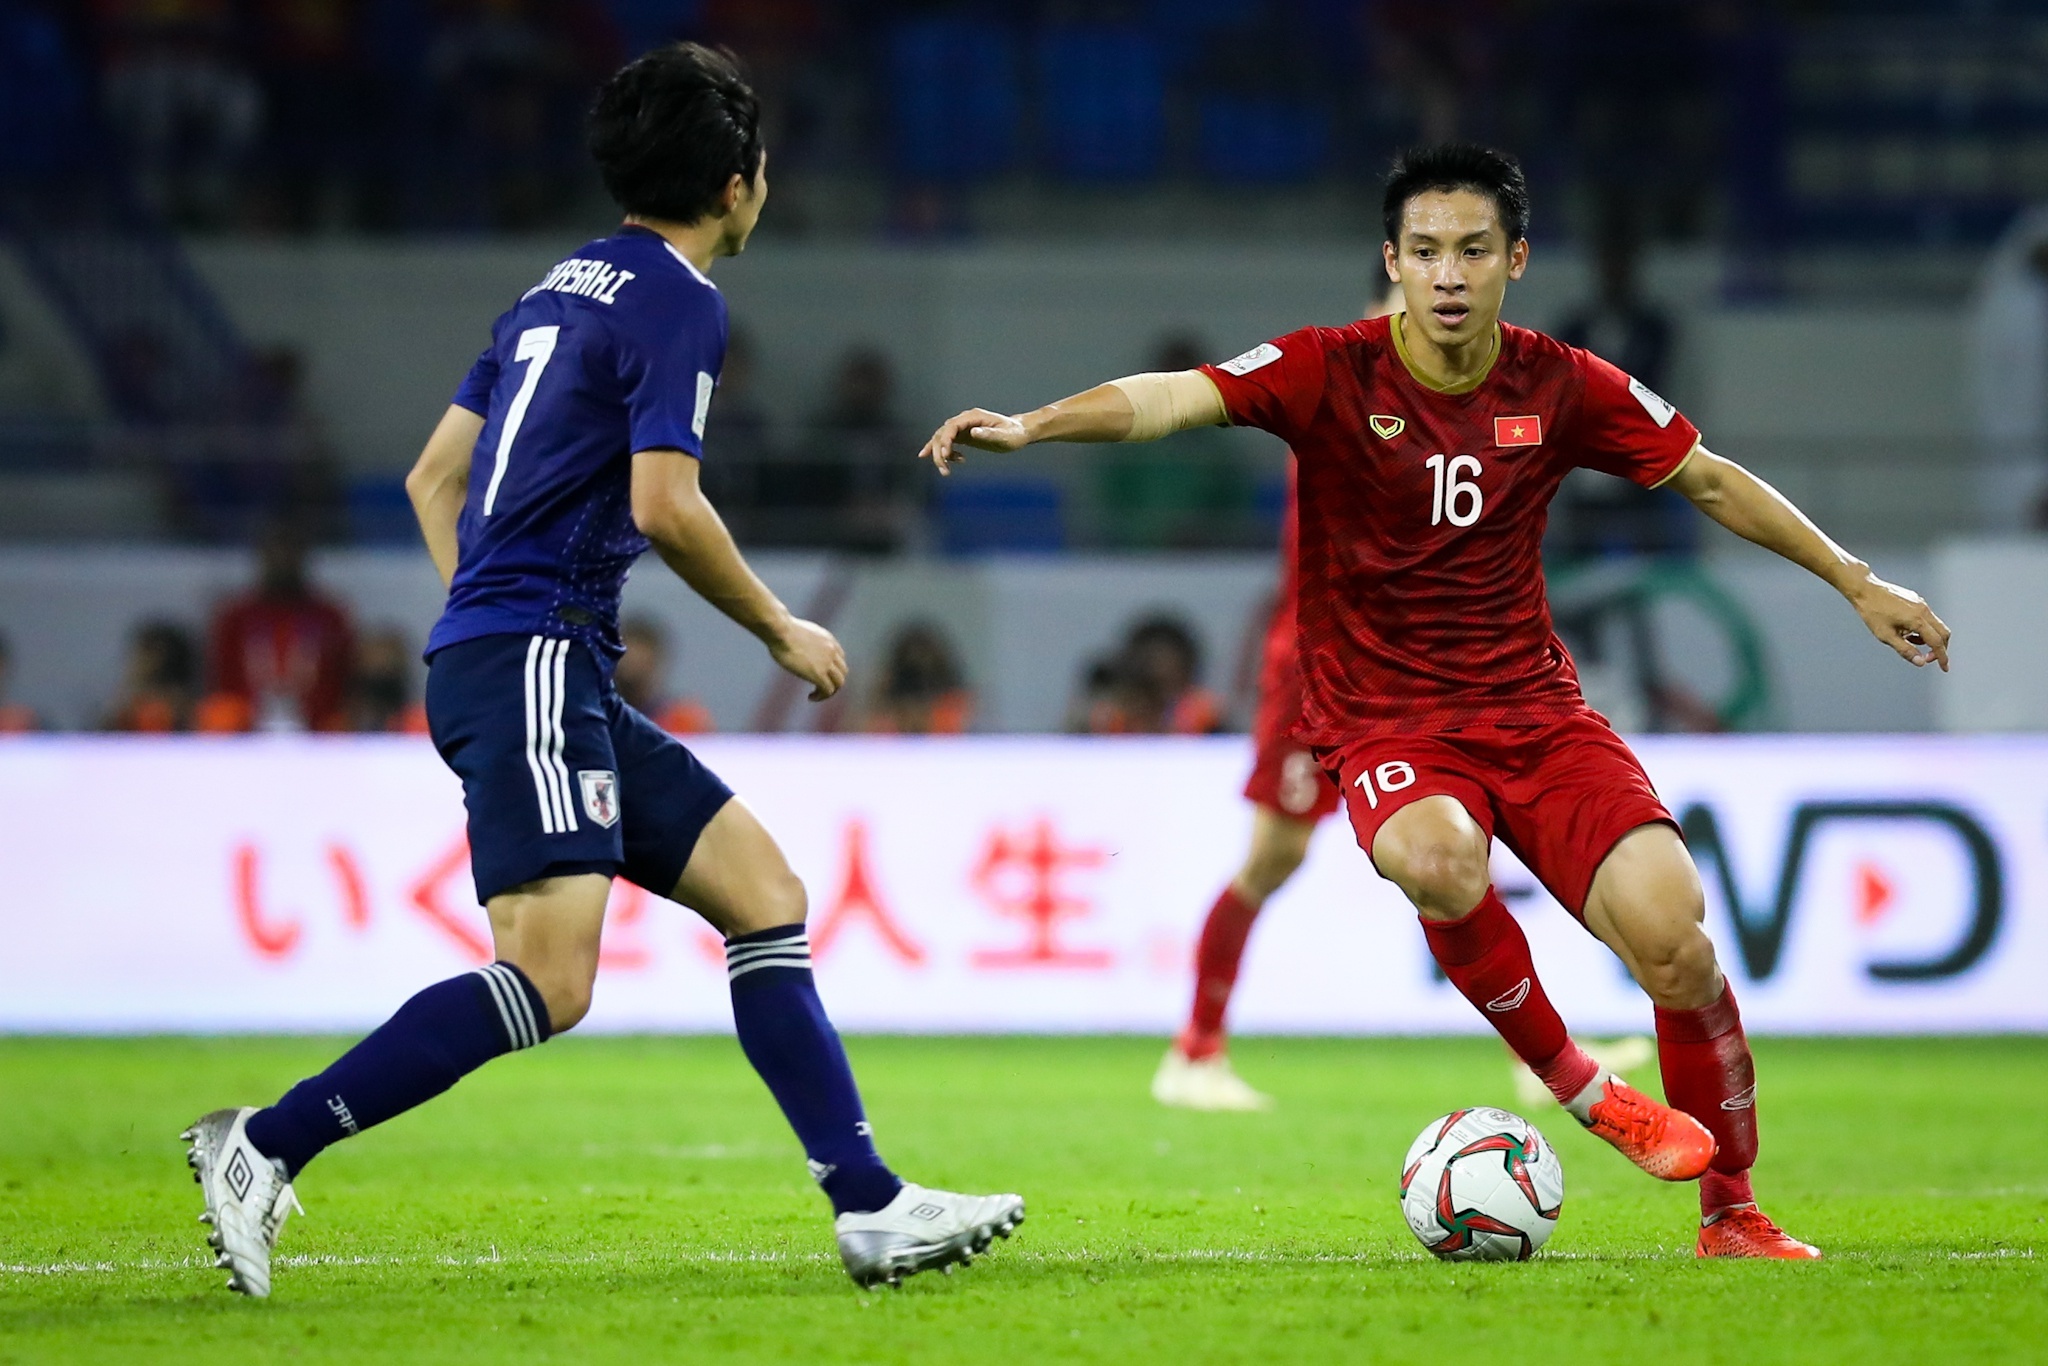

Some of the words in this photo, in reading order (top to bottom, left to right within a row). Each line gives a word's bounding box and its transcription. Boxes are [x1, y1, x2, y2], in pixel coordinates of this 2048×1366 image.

[484, 326, 560, 517] 7
[1426, 454, 1482, 527] 16
[1354, 761, 1416, 809] 16
[1430, 800, 2005, 983] WD
